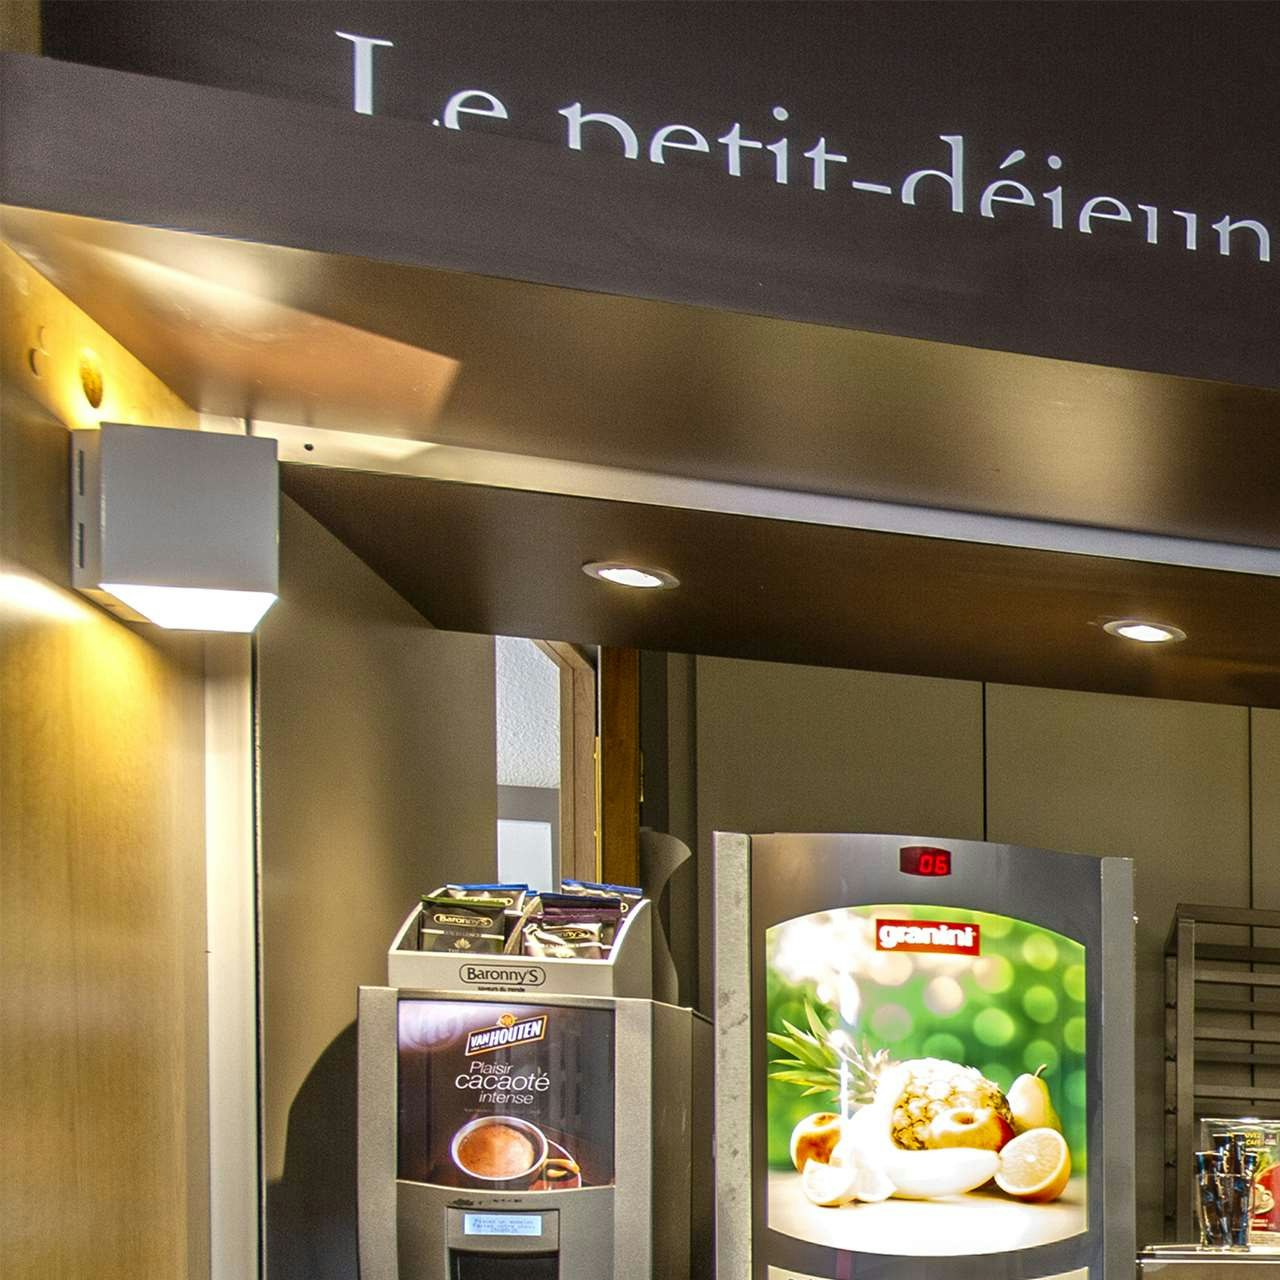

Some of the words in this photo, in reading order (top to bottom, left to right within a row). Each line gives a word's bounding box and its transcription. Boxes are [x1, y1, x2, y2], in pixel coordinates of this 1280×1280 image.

[919, 855, 948, 874] 06
[879, 924, 974, 949] granini
[469, 1060, 514, 1074] Plaisir
[455, 1073, 550, 1092] cacaoté
[478, 1091, 534, 1105] intense
